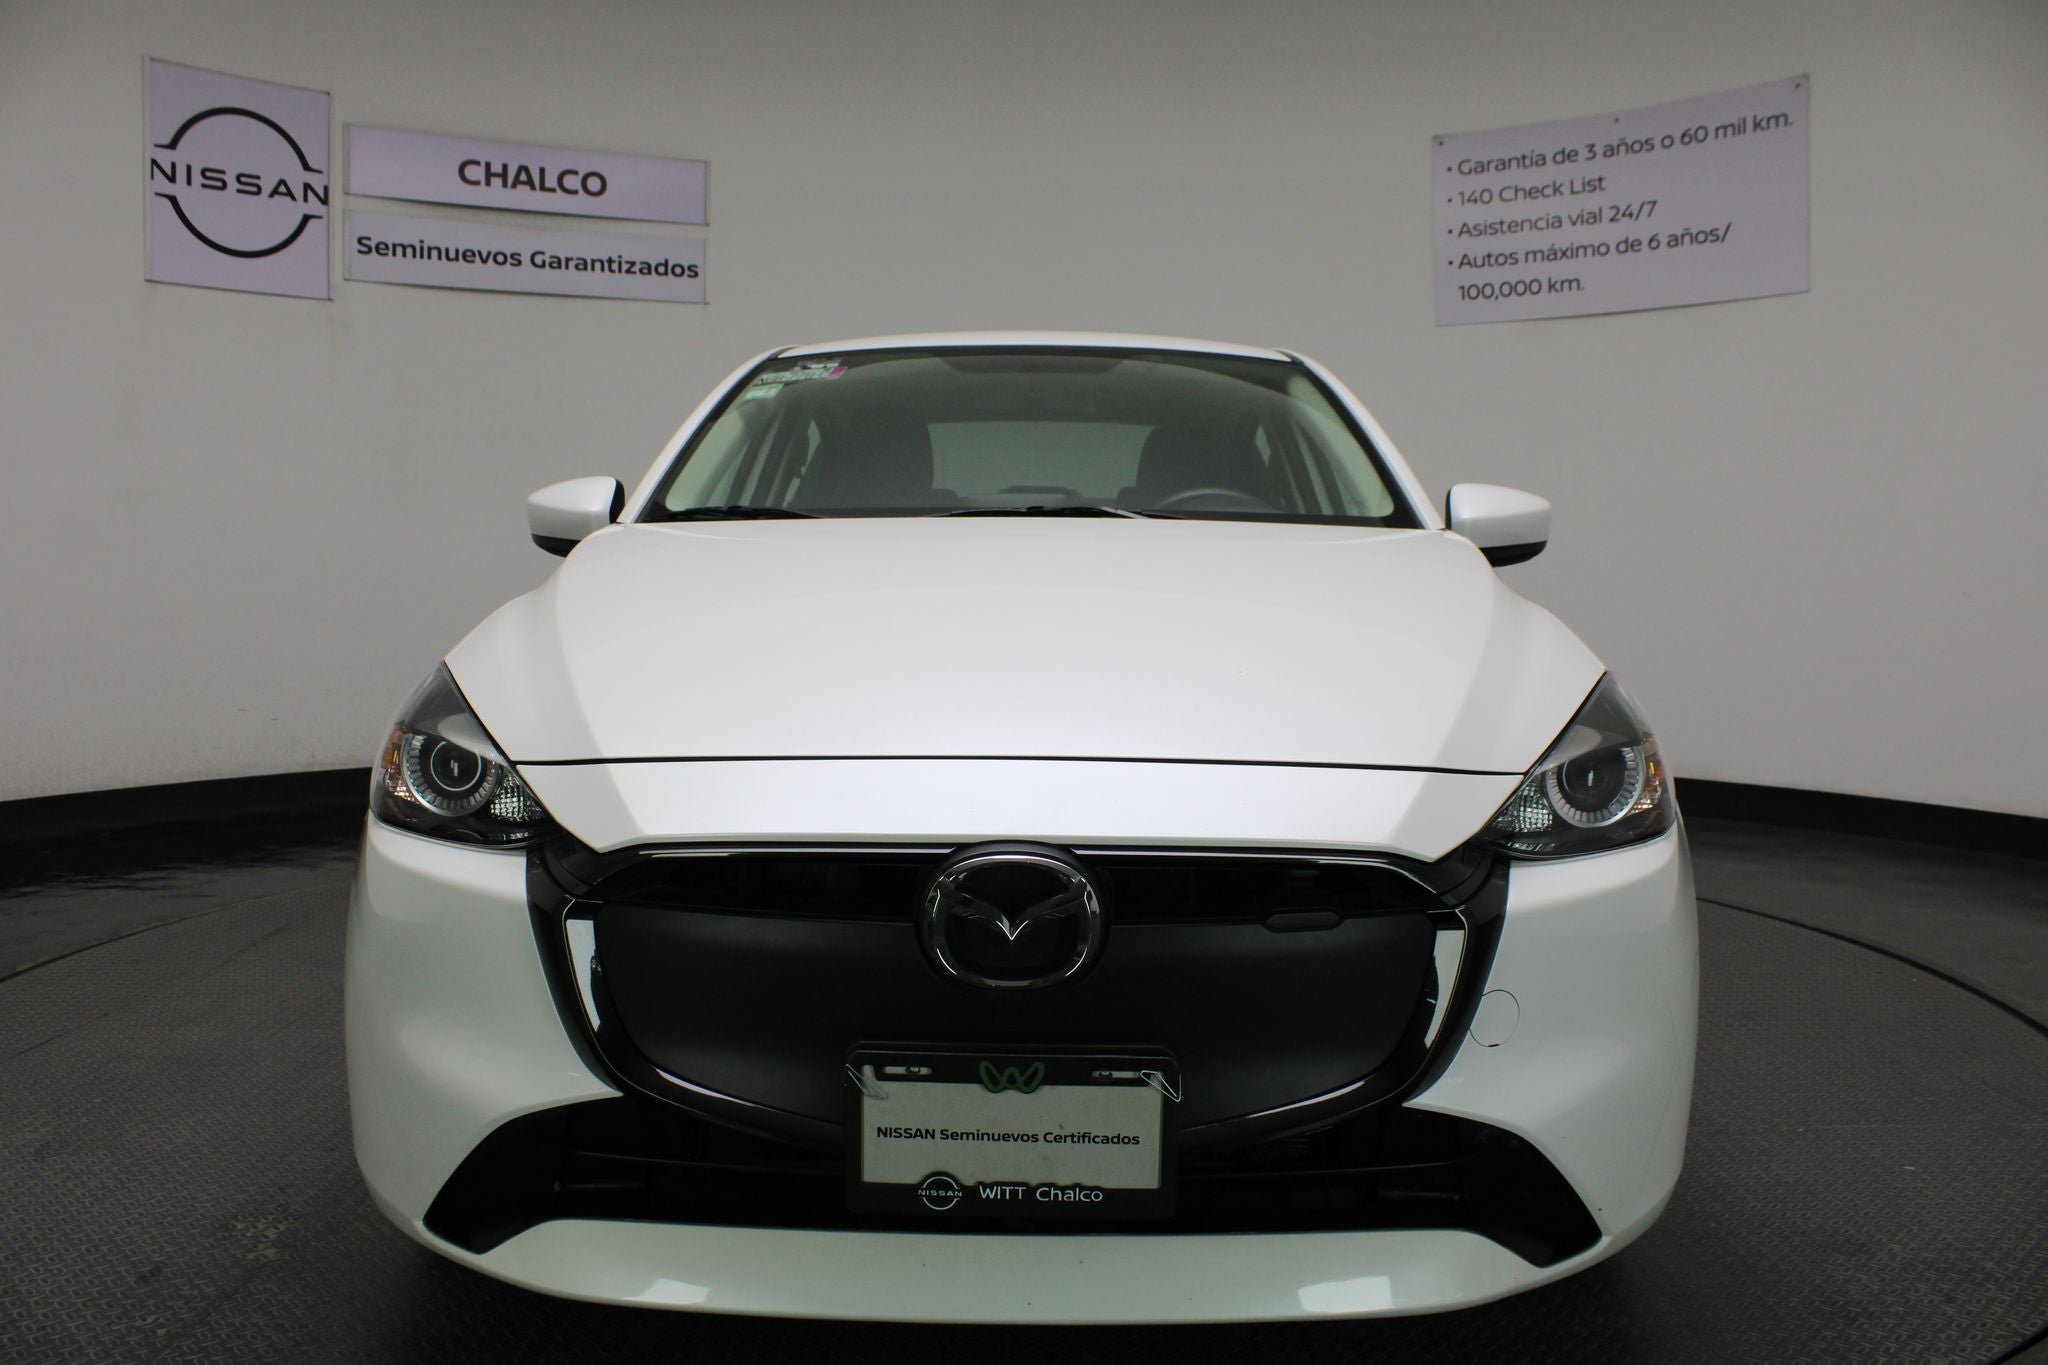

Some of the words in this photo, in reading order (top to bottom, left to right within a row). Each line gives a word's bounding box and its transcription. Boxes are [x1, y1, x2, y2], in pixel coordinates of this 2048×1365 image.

[1457, 149, 1548, 177] Garantía
[1552, 146, 1580, 167] de
[1585, 143, 1597, 162] 3
[1602, 136, 1656, 159] años
[1660, 134, 1675, 150] o
[1680, 126, 1708, 147] 60
[1714, 115, 1747, 140] mil
[1753, 109, 1794, 134] km.
[150, 157, 329, 206] NISSAN
[457, 158, 608, 197] CHALCO
[1458, 187, 1494, 207] 140
[1498, 180, 1564, 203] Check
[1570, 175, 1607, 196] List
[1457, 213, 1563, 239] Asistencia
[1568, 206, 1602, 227] vial
[1609, 200, 1658, 224] 24/7
[356, 235, 523, 268] Seminuevos
[529, 249, 700, 279] Garantizados
[1457, 250, 1519, 272] Autos
[1524, 238, 1610, 264] máximo
[1615, 235, 1643, 254] de
[1648, 232, 1661, 251] 6
[1667, 222, 1732, 249] años/
[1458, 277, 1542, 303] 100,000
[1547, 274, 1585, 294] km.
[876, 1126, 936, 1140] NISSAN
[940, 1129, 1039, 1144] Seminuevos
[1043, 1131, 1140, 1146] Certificados
[918, 1187, 963, 1198] NISSAN
[978, 1185, 1027, 1201] WITT
[1035, 1186, 1103, 1202] Chalco
